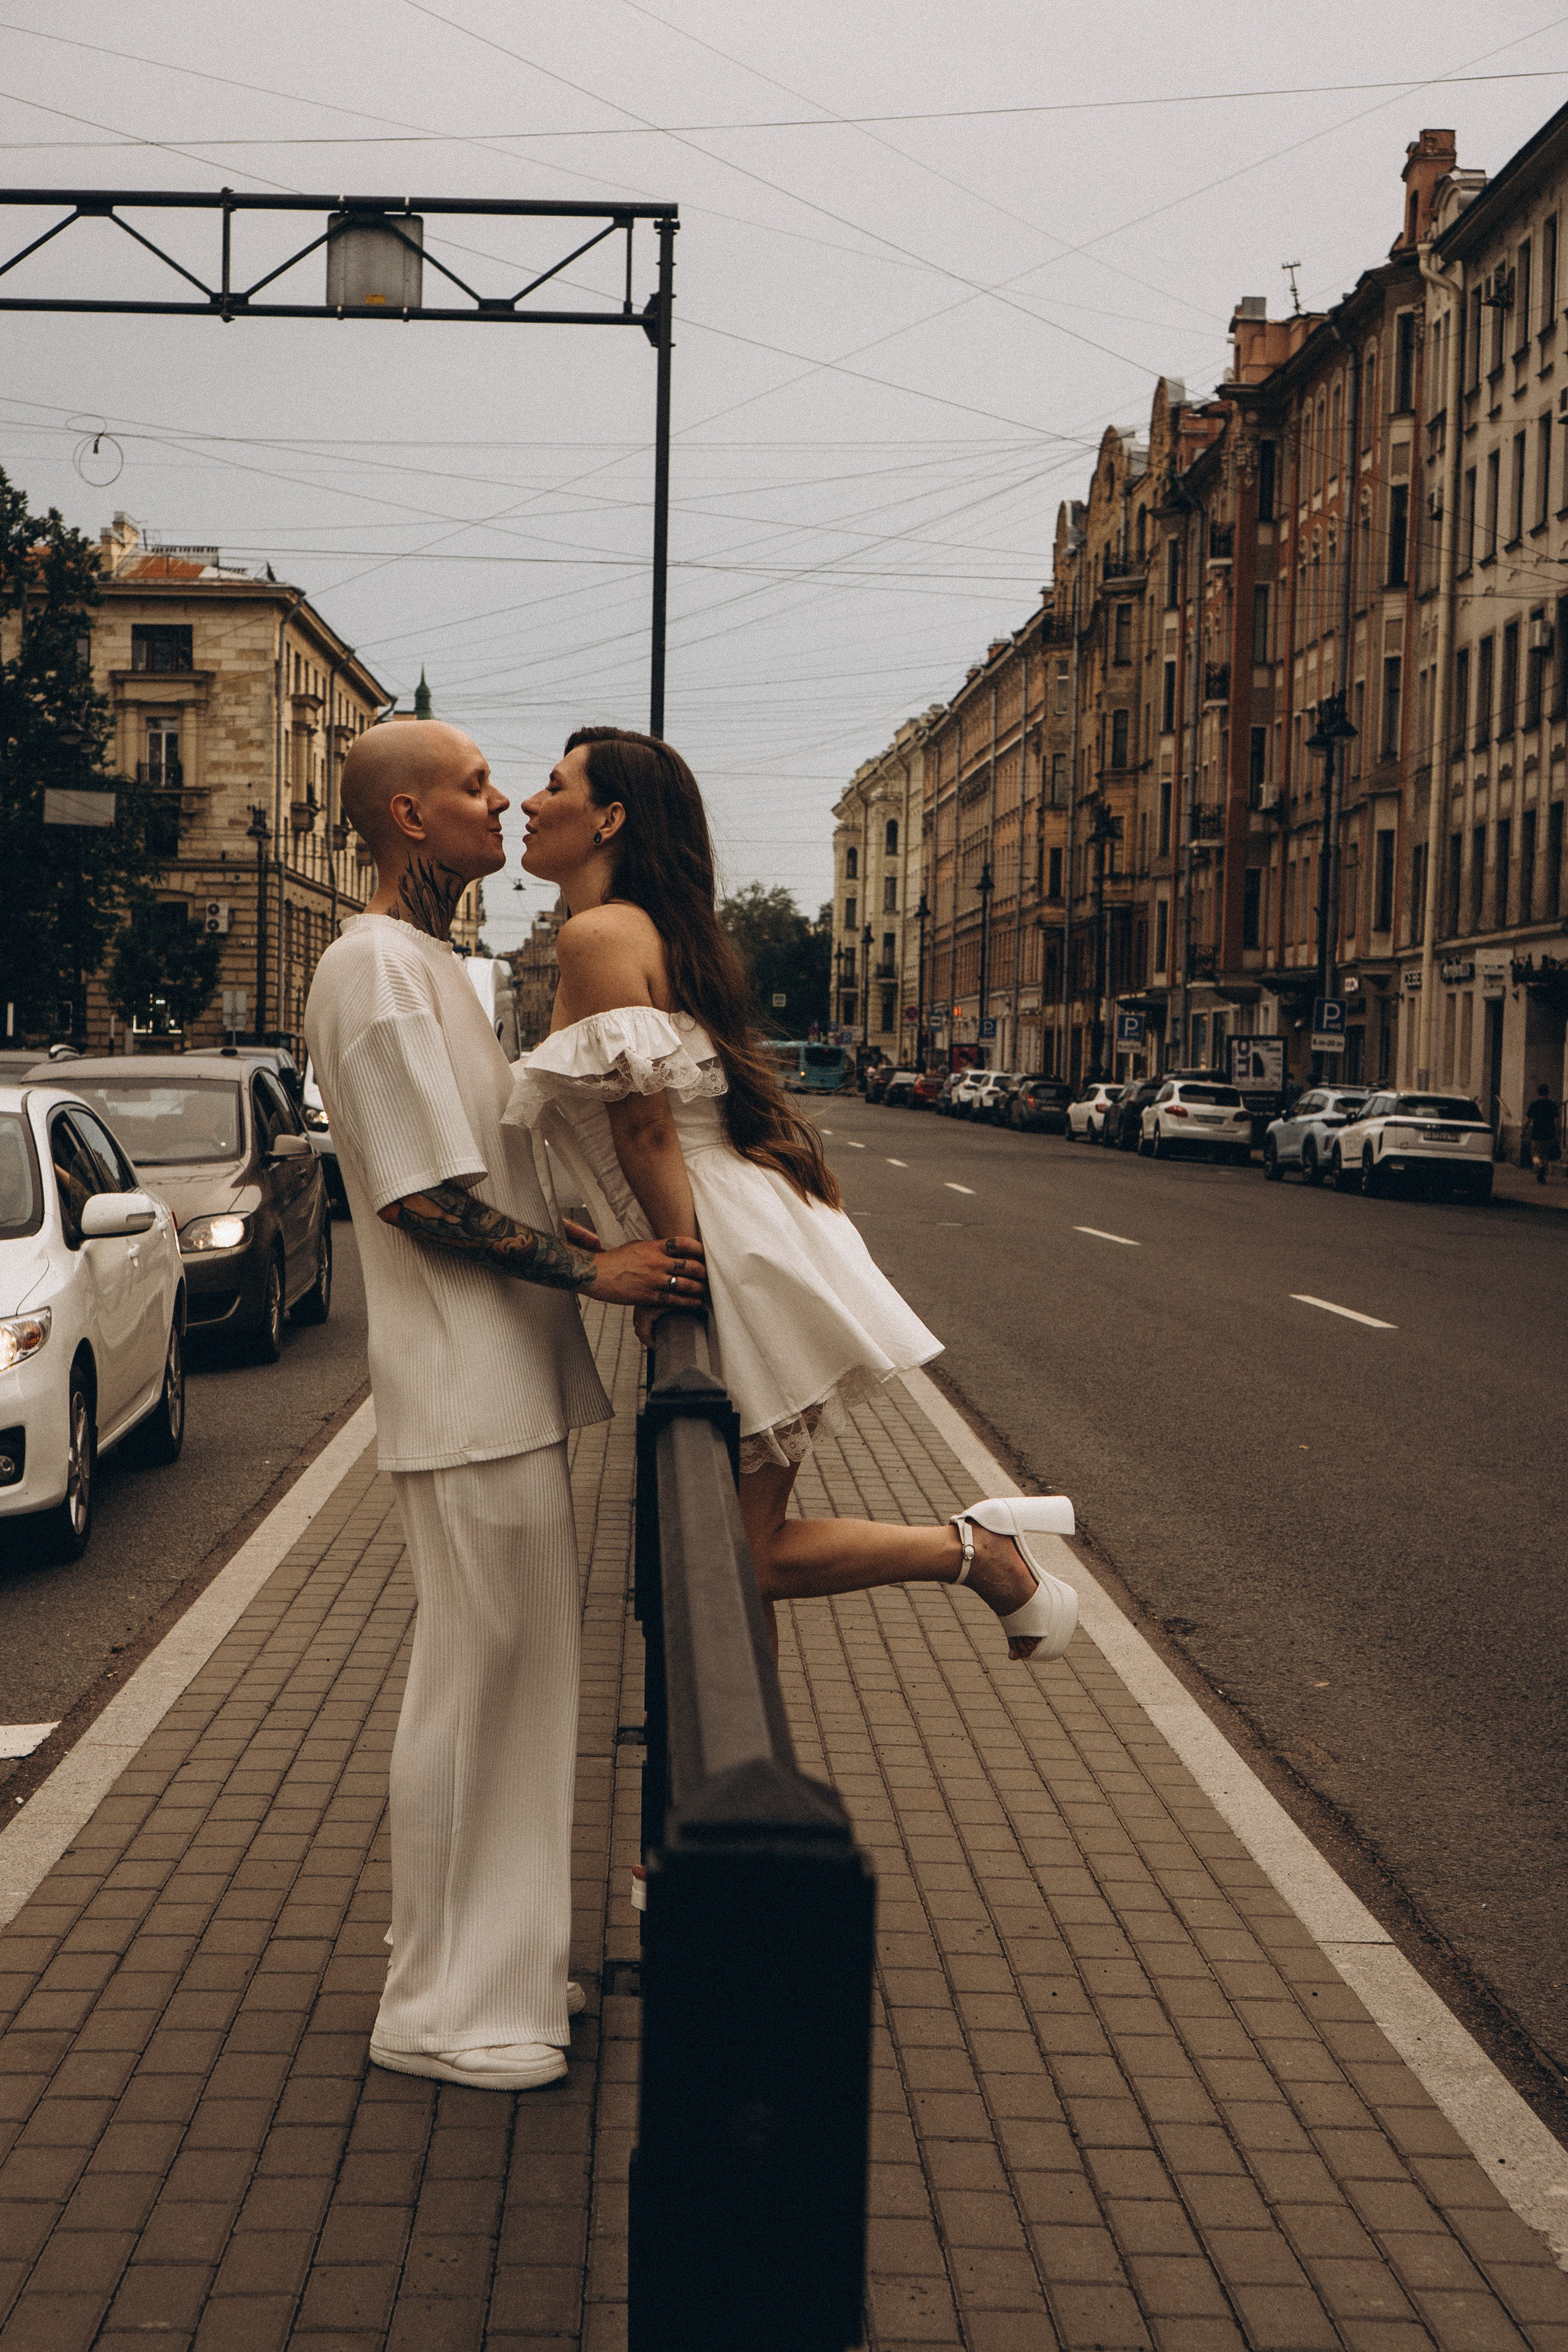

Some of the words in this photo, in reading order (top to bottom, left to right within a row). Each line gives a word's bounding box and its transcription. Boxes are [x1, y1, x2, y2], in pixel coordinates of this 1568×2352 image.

[1322, 1003, 1340, 1029] P
[983, 1021, 994, 1035] P
[1124, 1017, 1139, 1036] P
